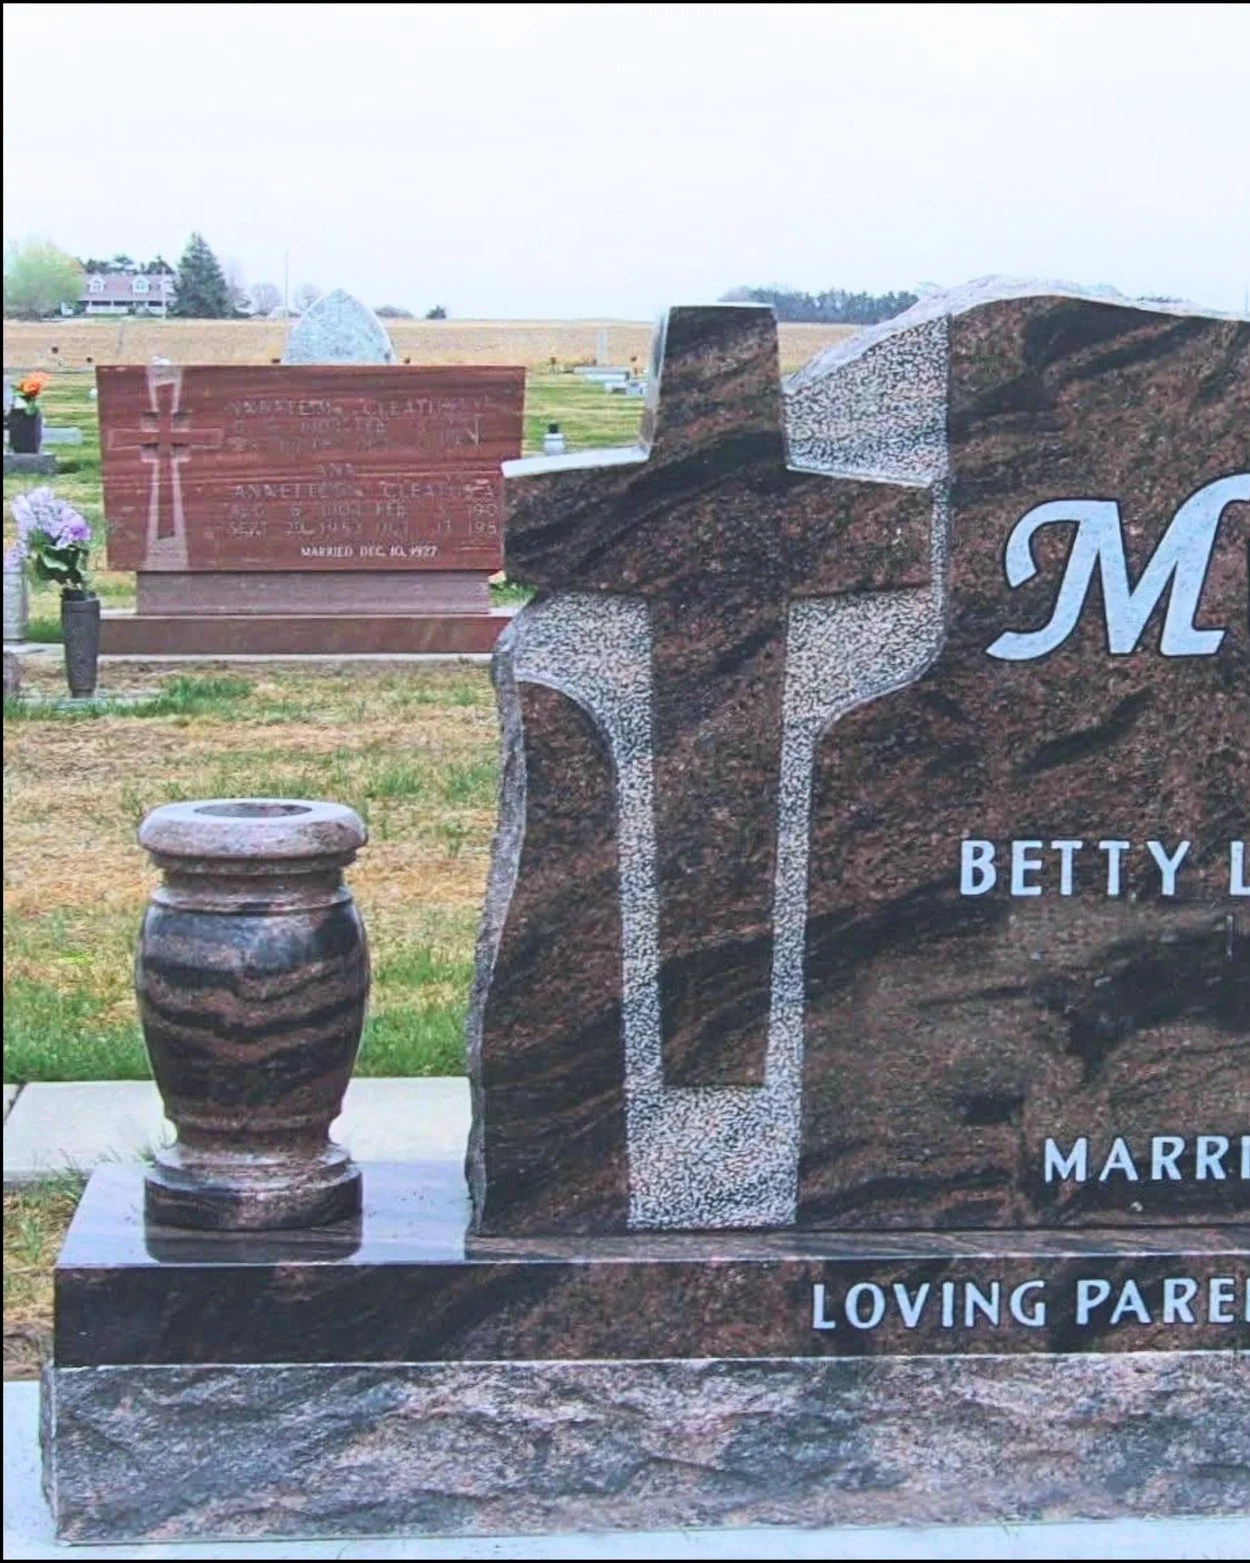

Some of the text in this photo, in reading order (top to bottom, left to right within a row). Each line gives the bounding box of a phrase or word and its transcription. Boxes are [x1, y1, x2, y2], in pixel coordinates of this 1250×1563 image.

[300, 545, 354, 558] MARRIED
[960, 840, 1191, 896] BETTY
[813, 1280, 1045, 1329] LOVING
